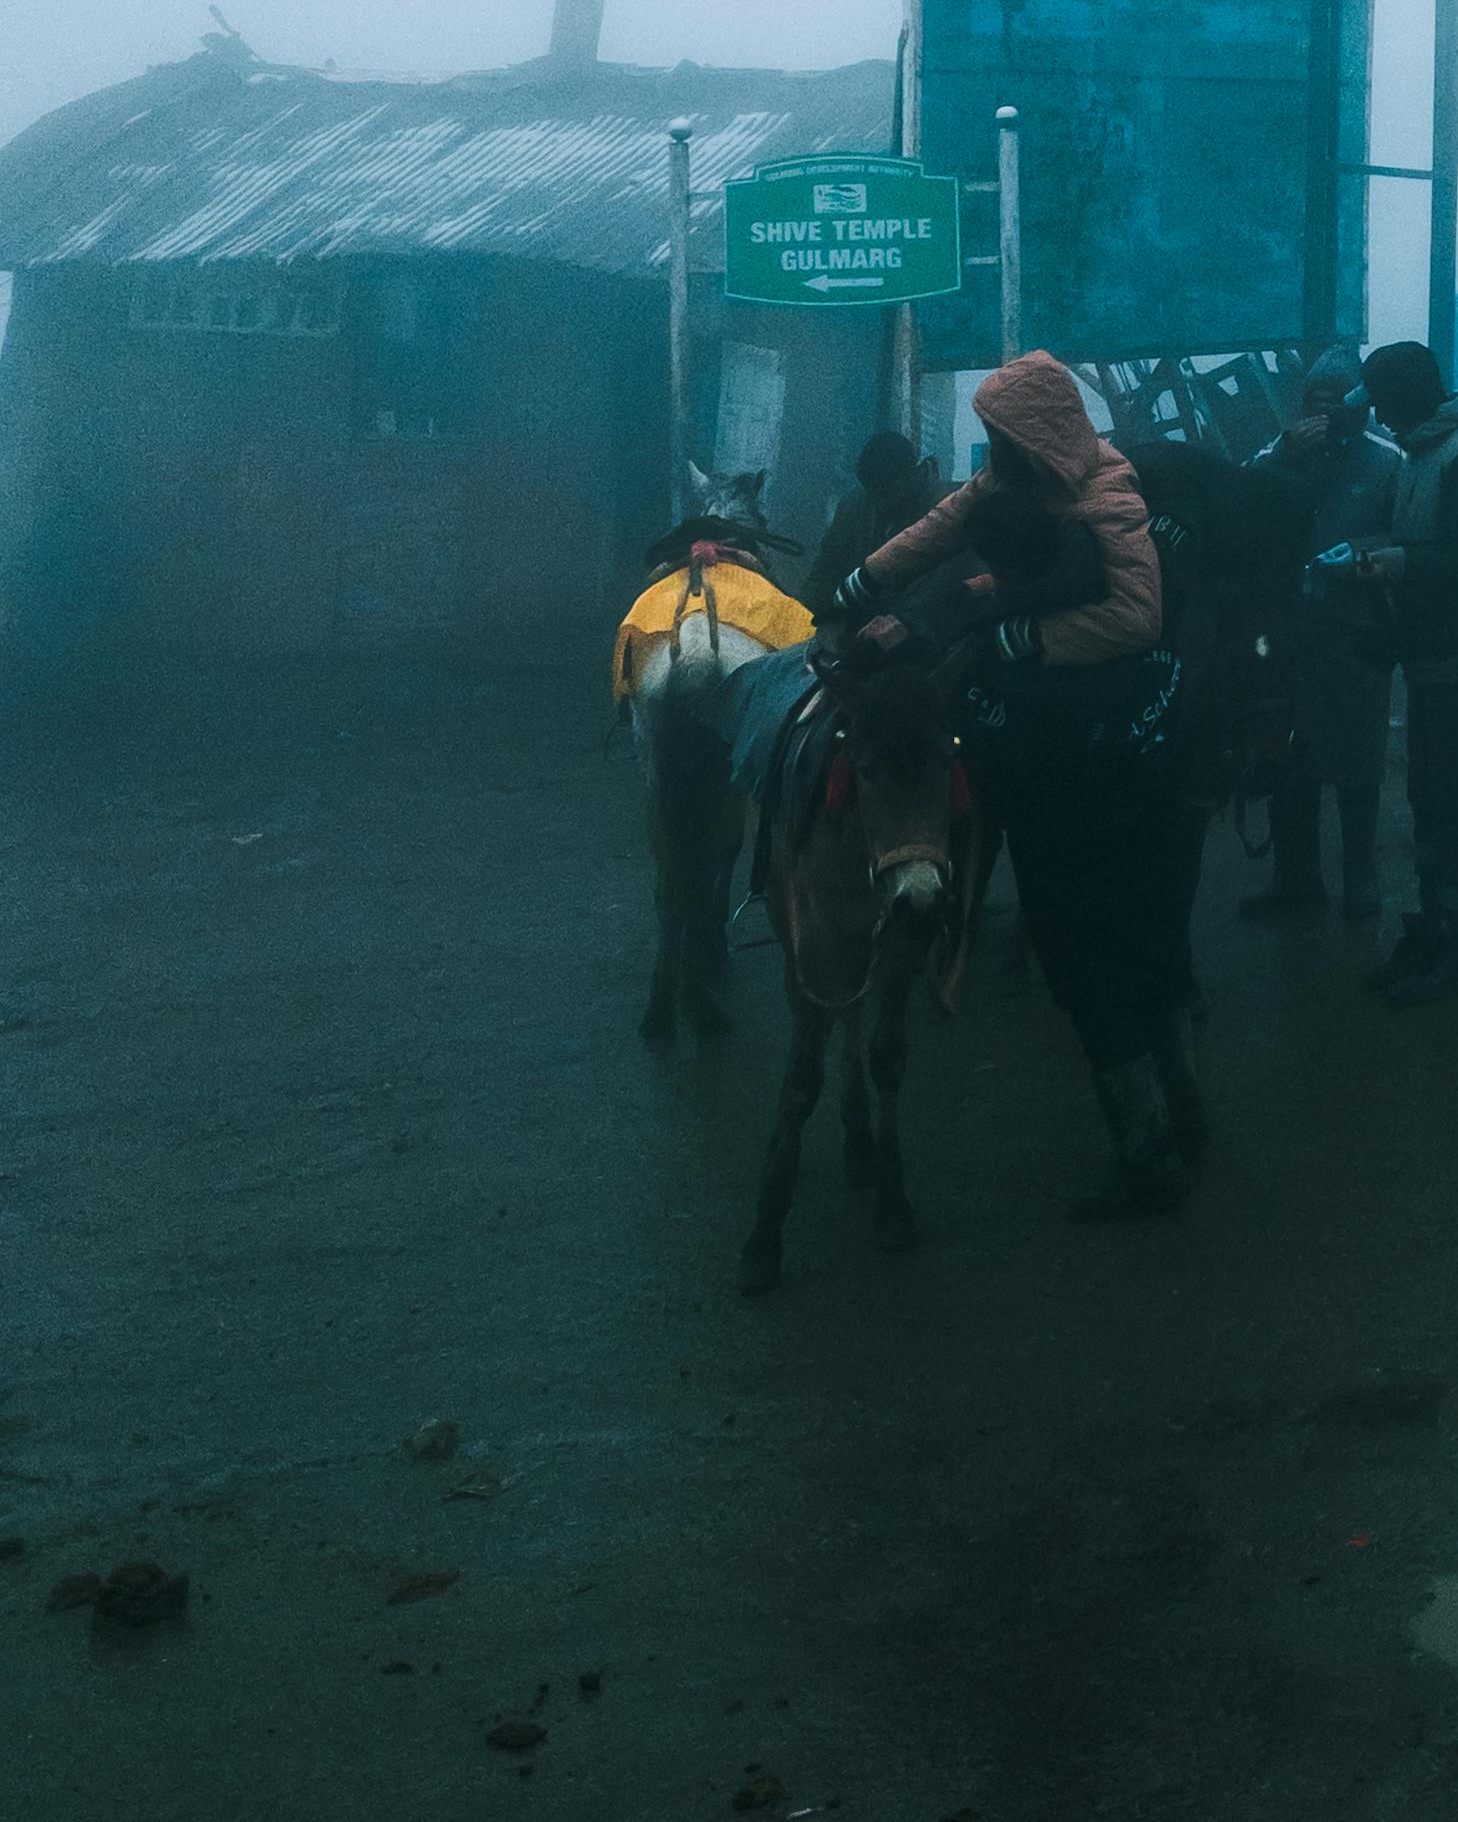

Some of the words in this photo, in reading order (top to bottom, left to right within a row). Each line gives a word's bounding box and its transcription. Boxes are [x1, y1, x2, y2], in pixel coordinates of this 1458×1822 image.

[750, 221, 822, 243] SHIVE
[832, 218, 932, 241] TEMPLE
[780, 247, 902, 271] GULMARG
